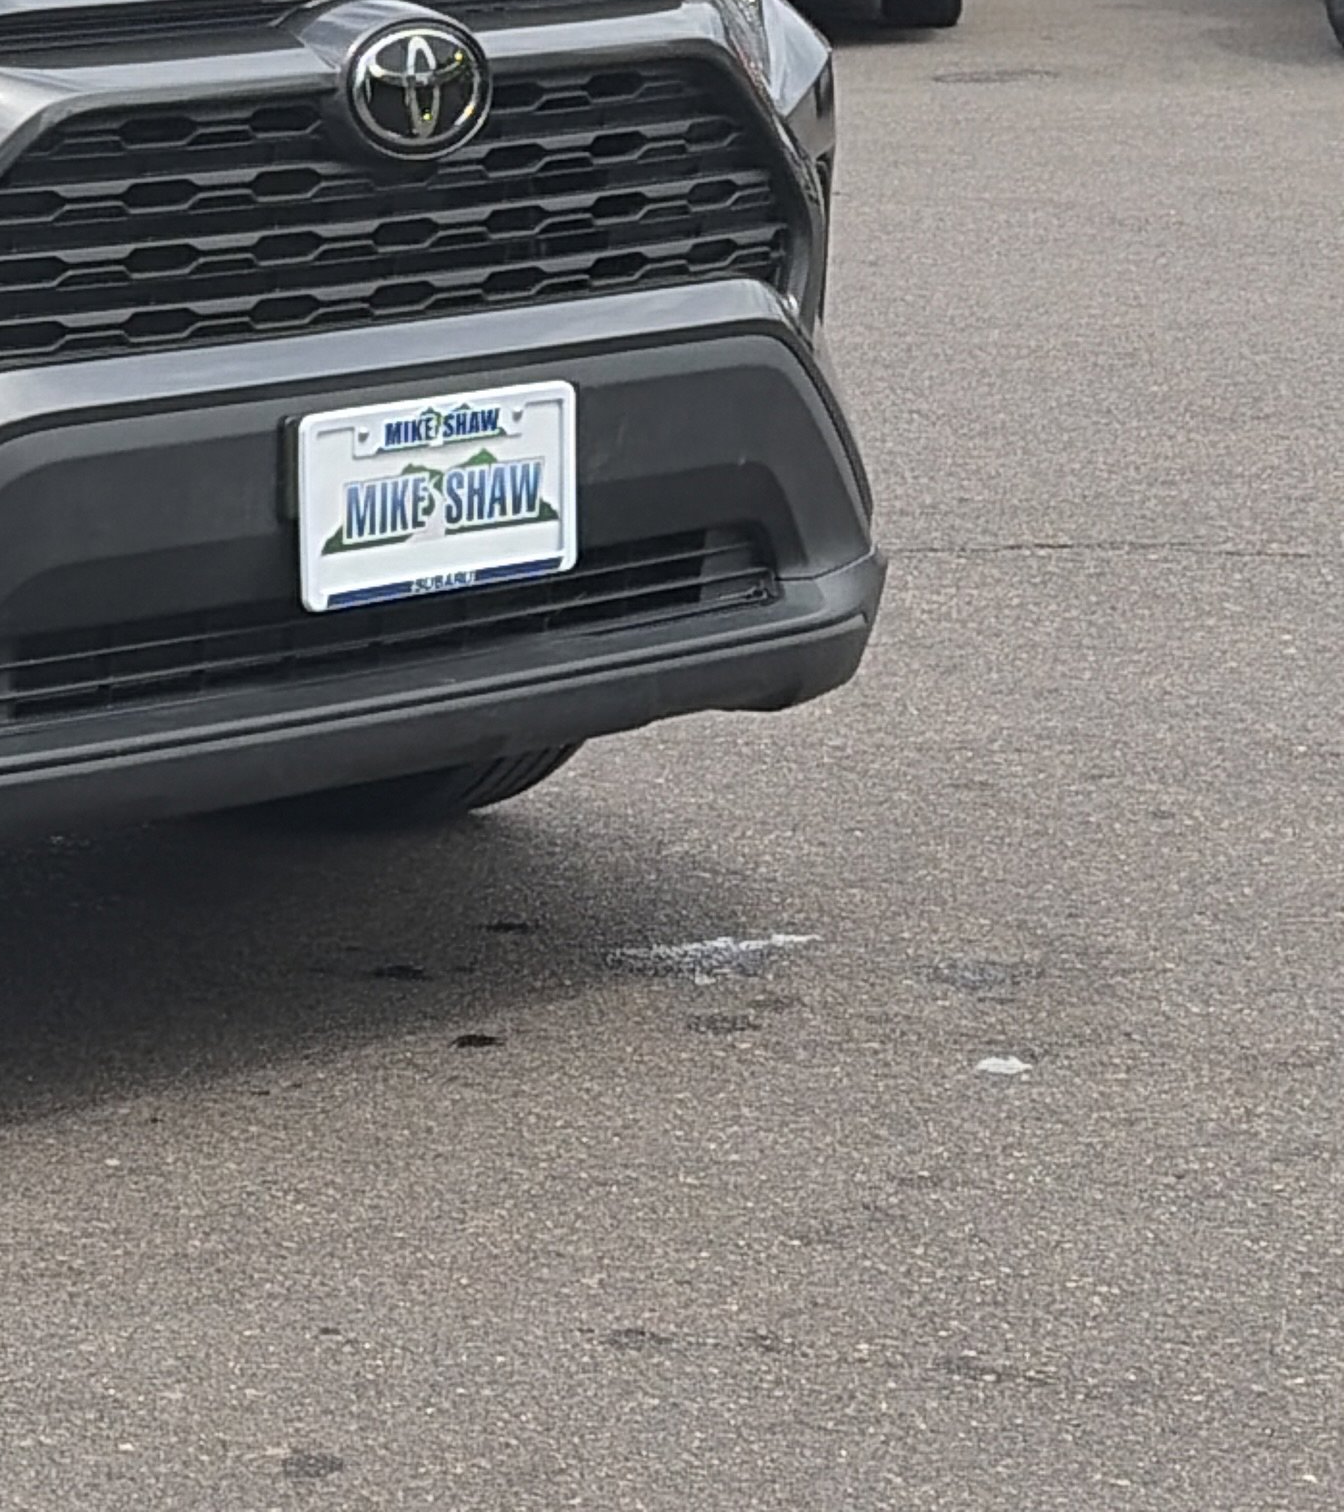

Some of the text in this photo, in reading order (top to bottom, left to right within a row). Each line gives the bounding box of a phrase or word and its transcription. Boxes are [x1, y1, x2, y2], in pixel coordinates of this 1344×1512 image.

[385, 407, 500, 446] MIKE SHAW
[346, 462, 541, 539] MIKE SHAW
[413, 571, 475, 593] SUBARU
